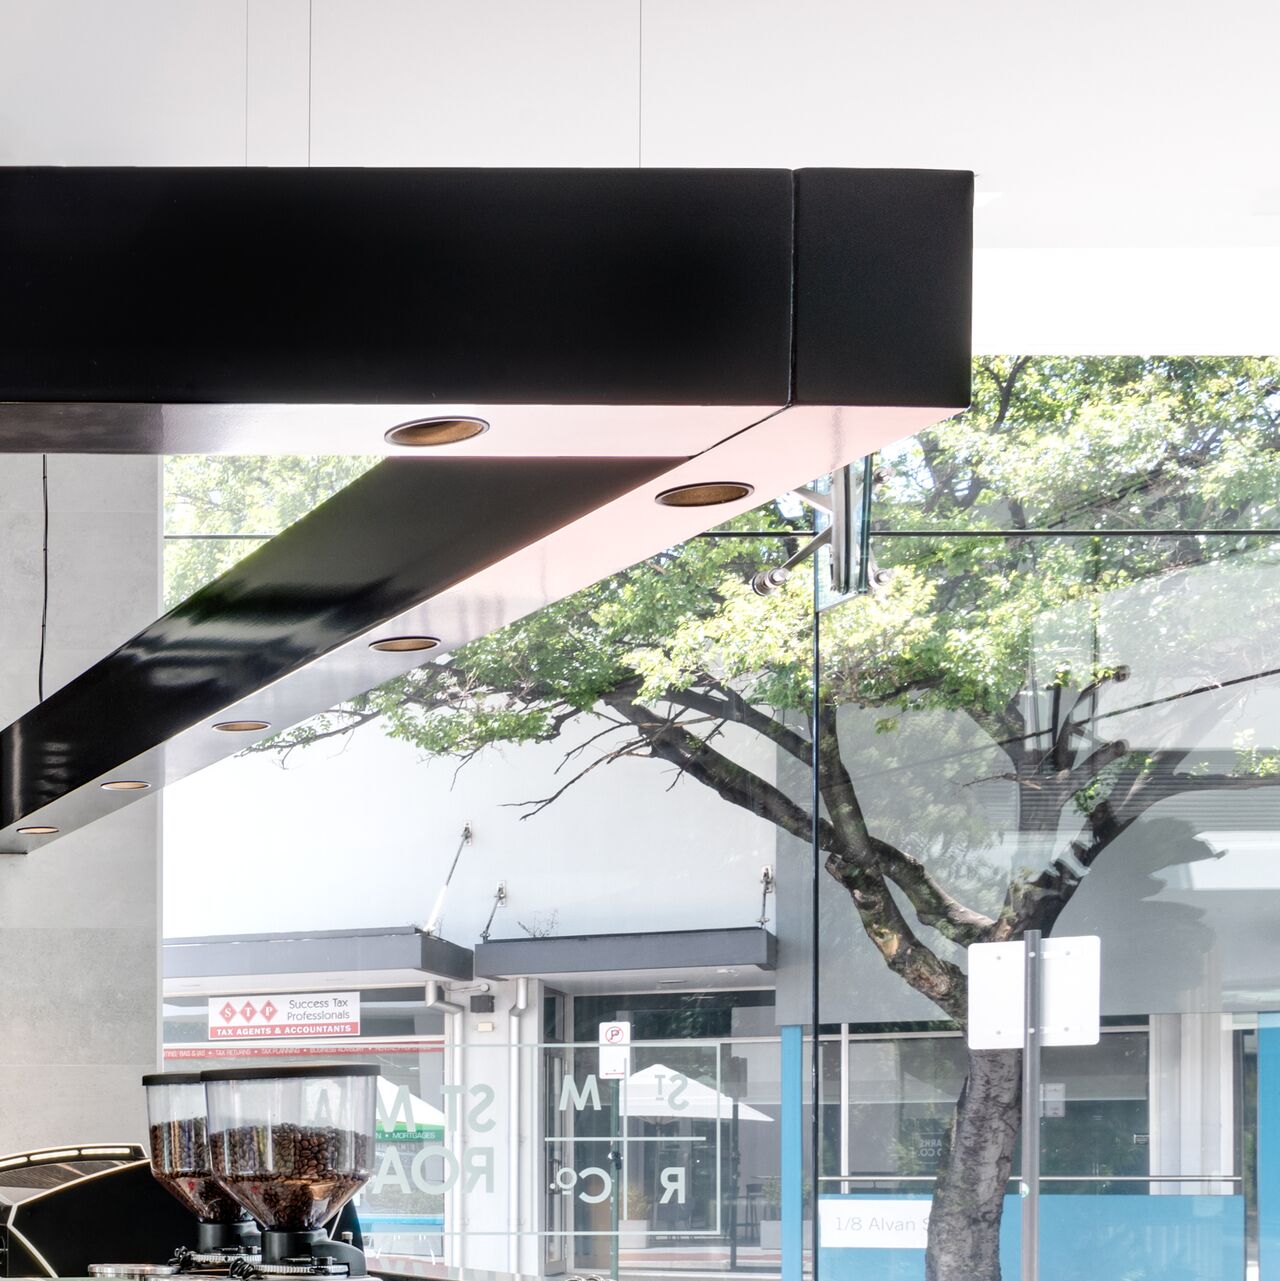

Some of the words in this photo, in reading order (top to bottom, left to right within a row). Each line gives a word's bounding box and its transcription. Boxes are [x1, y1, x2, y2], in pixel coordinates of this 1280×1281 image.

[289, 999, 329, 1010] Success
[332, 998, 349, 1008] Tax
[287, 1009, 351, 1022] Professionals
[216, 1027, 234, 1036] TAX
[236, 1026, 272, 1036] AGENTS
[274, 1026, 282, 1035] &
[284, 1024, 353, 1035] ACCOUNTANTS
[392, 1131, 436, 1141] MORTGAGES
[835, 1216, 862, 1231] 1/8
[868, 1216, 916, 1231] Alvan
